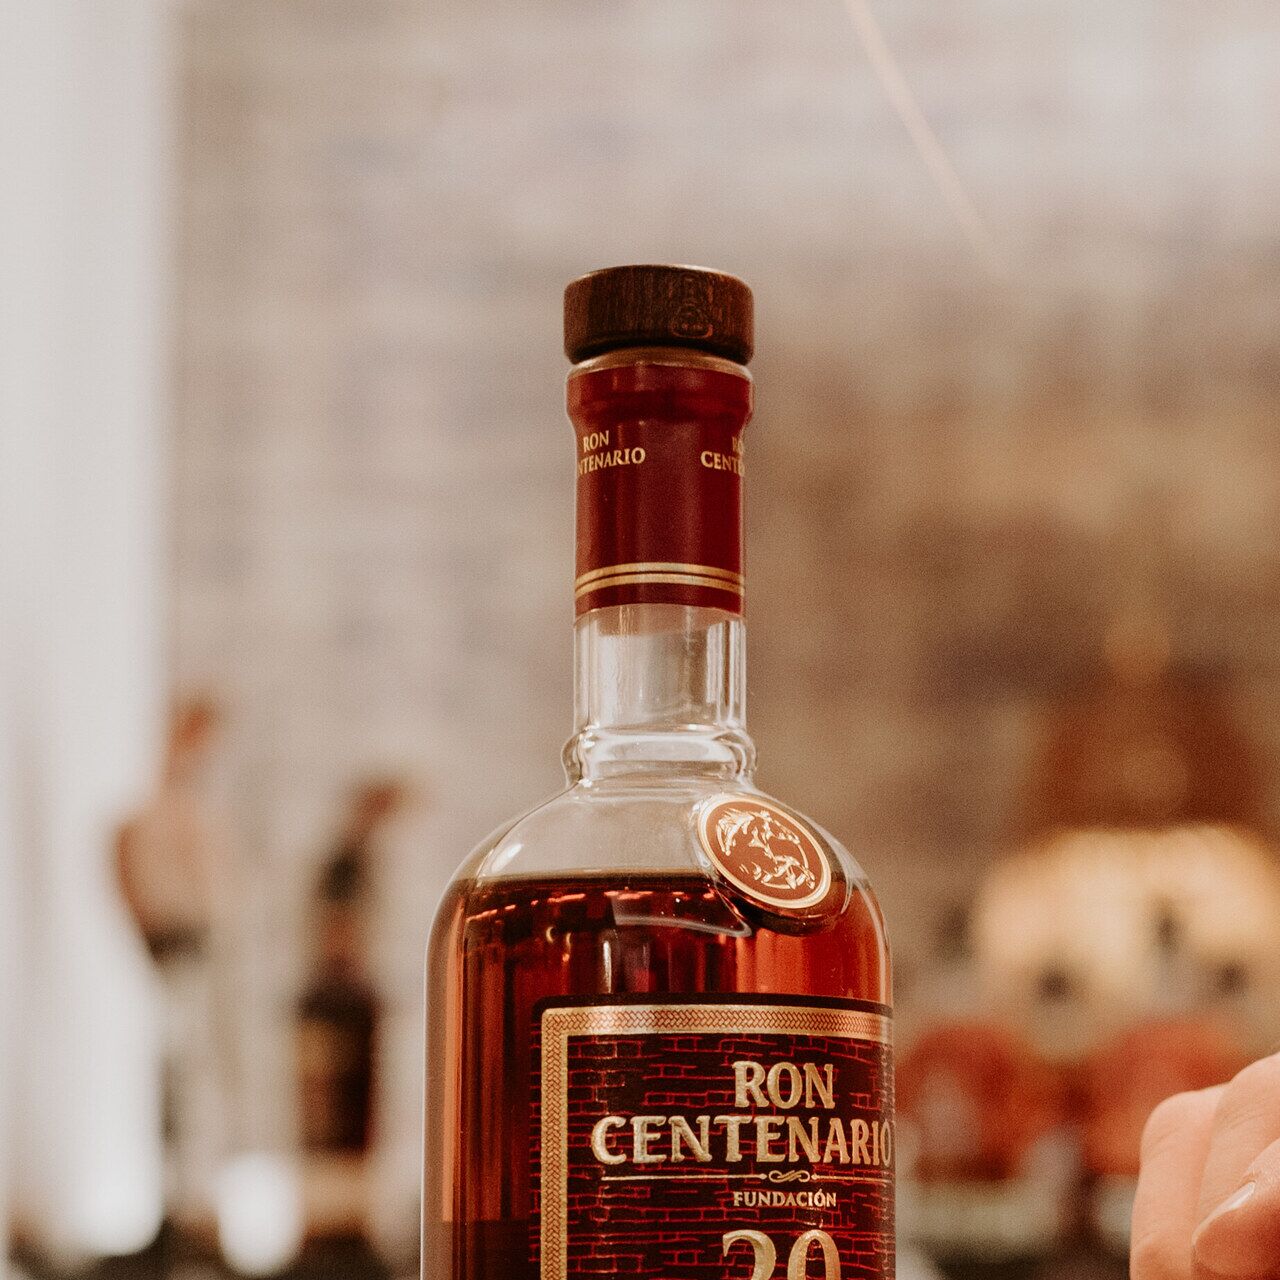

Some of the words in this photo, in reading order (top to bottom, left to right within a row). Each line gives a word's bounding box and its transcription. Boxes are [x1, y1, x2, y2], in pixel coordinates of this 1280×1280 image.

[583, 430, 610, 453] RON
[731, 1060, 836, 1110] RON
[591, 1115, 892, 1166] CENTENARIO
[733, 1188, 837, 1208] FUNDACIÓN
